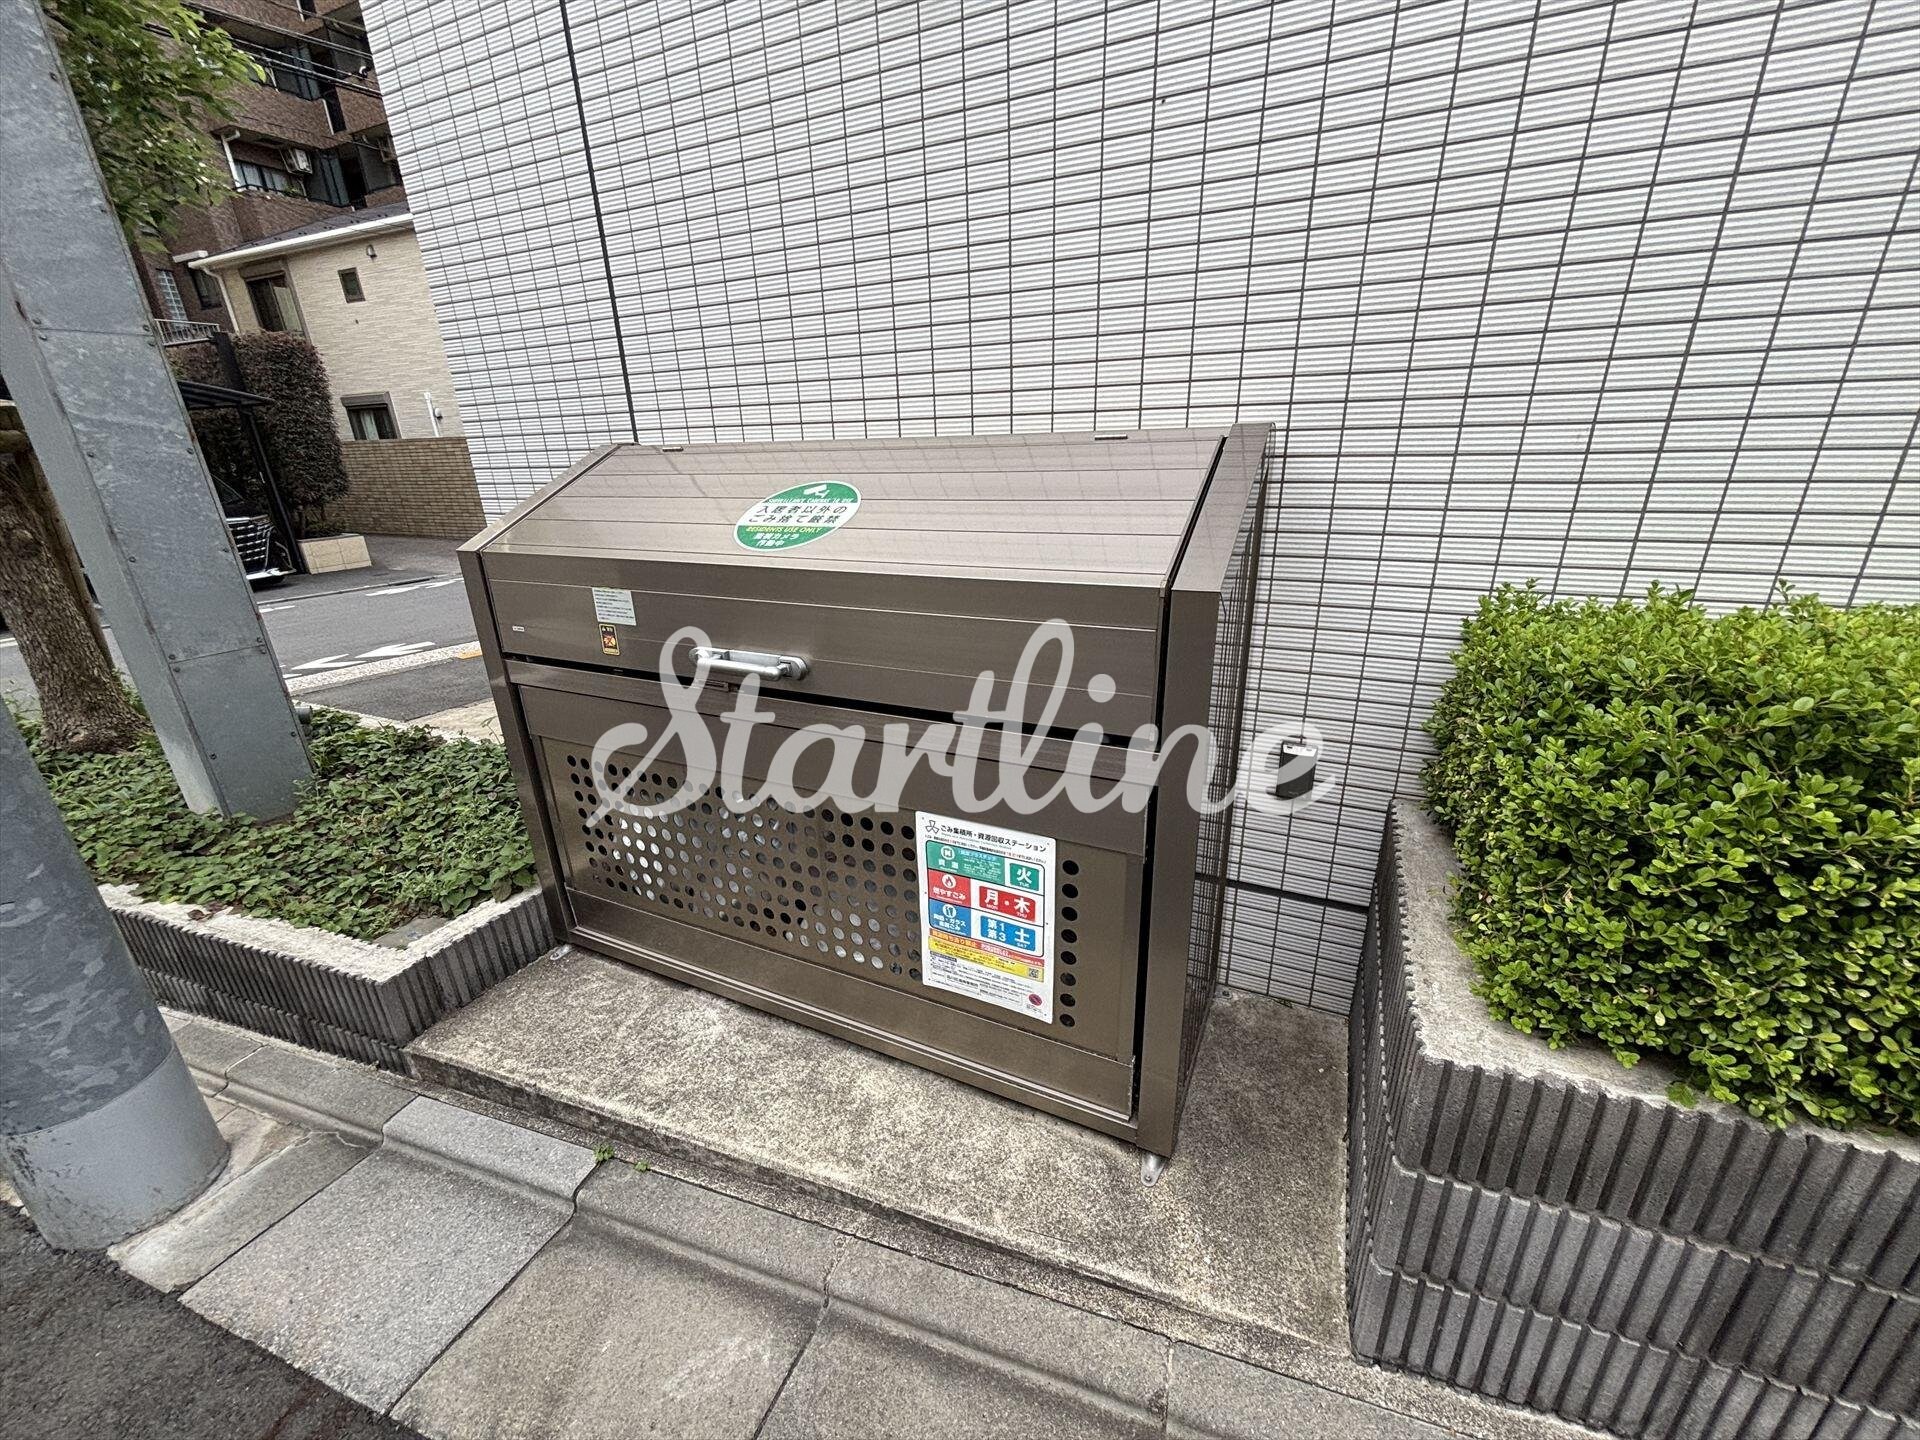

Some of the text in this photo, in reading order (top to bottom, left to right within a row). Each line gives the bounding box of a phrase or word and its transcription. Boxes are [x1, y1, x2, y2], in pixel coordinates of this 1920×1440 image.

[756, 505, 848, 514] 入居者以外の
[1016, 867, 1032, 884] 火
[932, 886, 967, 901] 燃やすごみ
[1014, 928, 1031, 945] 土
